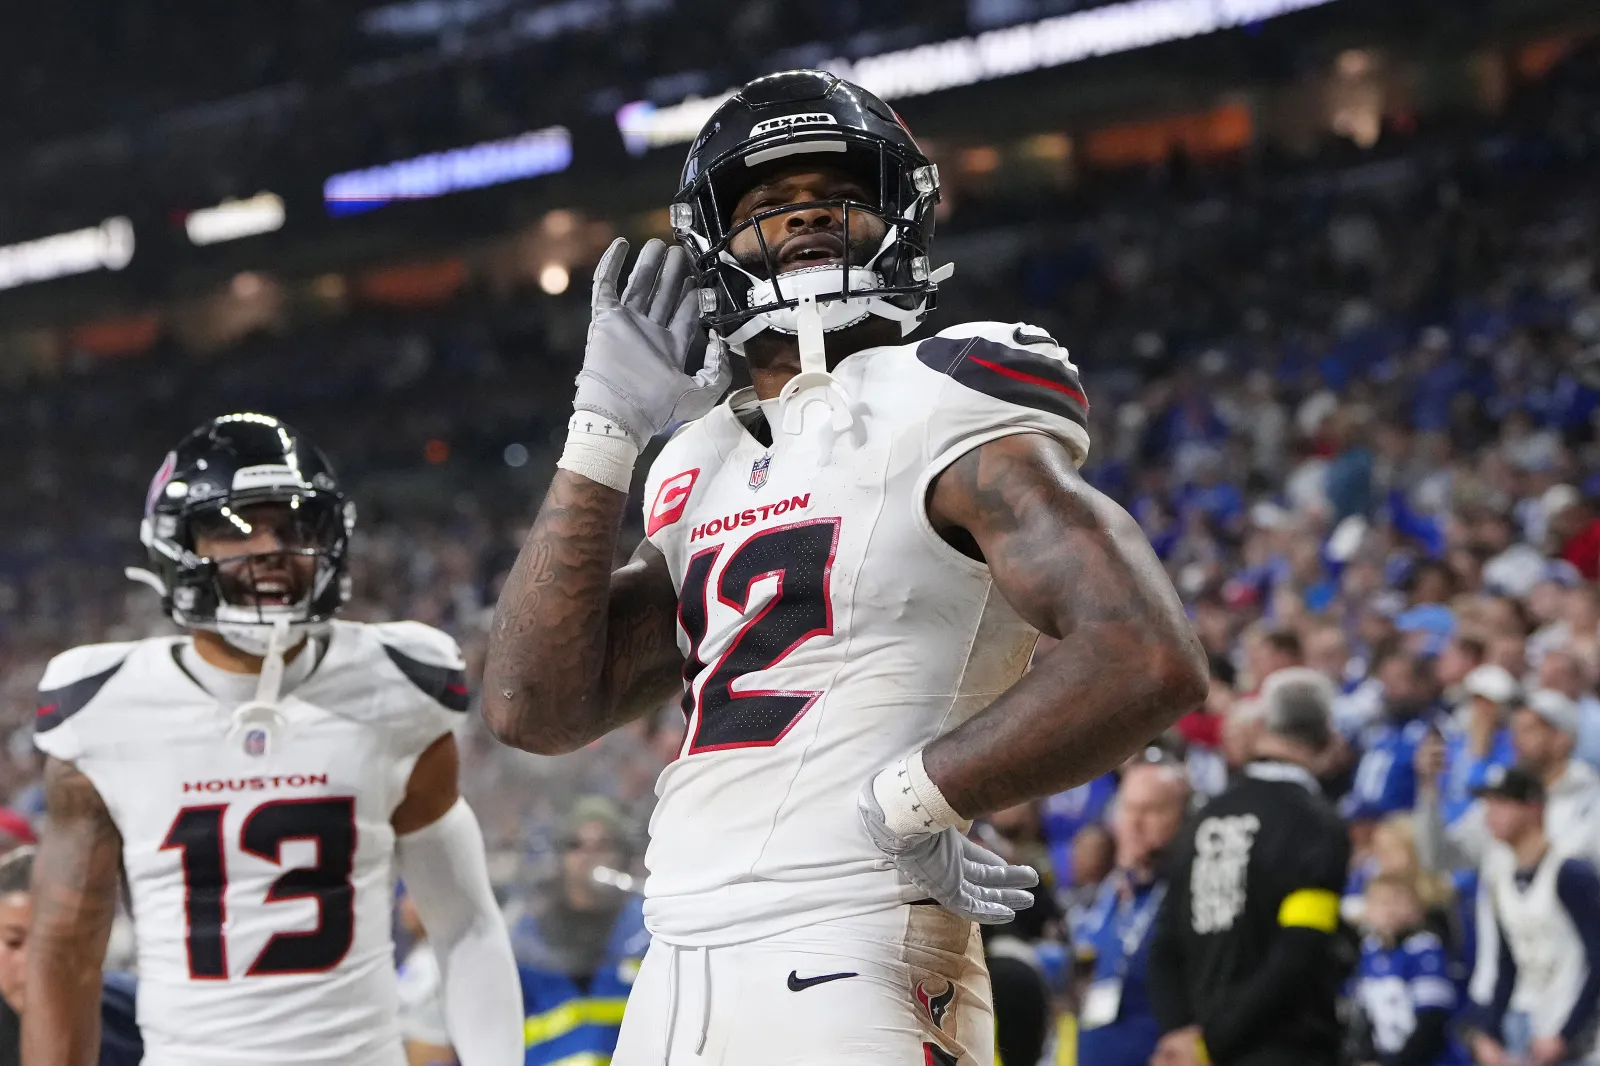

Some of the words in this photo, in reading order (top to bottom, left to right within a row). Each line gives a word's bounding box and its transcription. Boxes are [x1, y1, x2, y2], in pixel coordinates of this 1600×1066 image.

[757, 115, 830, 131] TEXANS
[653, 473, 693, 518] C
[690, 493, 811, 543] HOUSTON
[679, 516, 842, 760] 12
[183, 773, 328, 793] HOUSTON
[158, 796, 358, 981] 13
